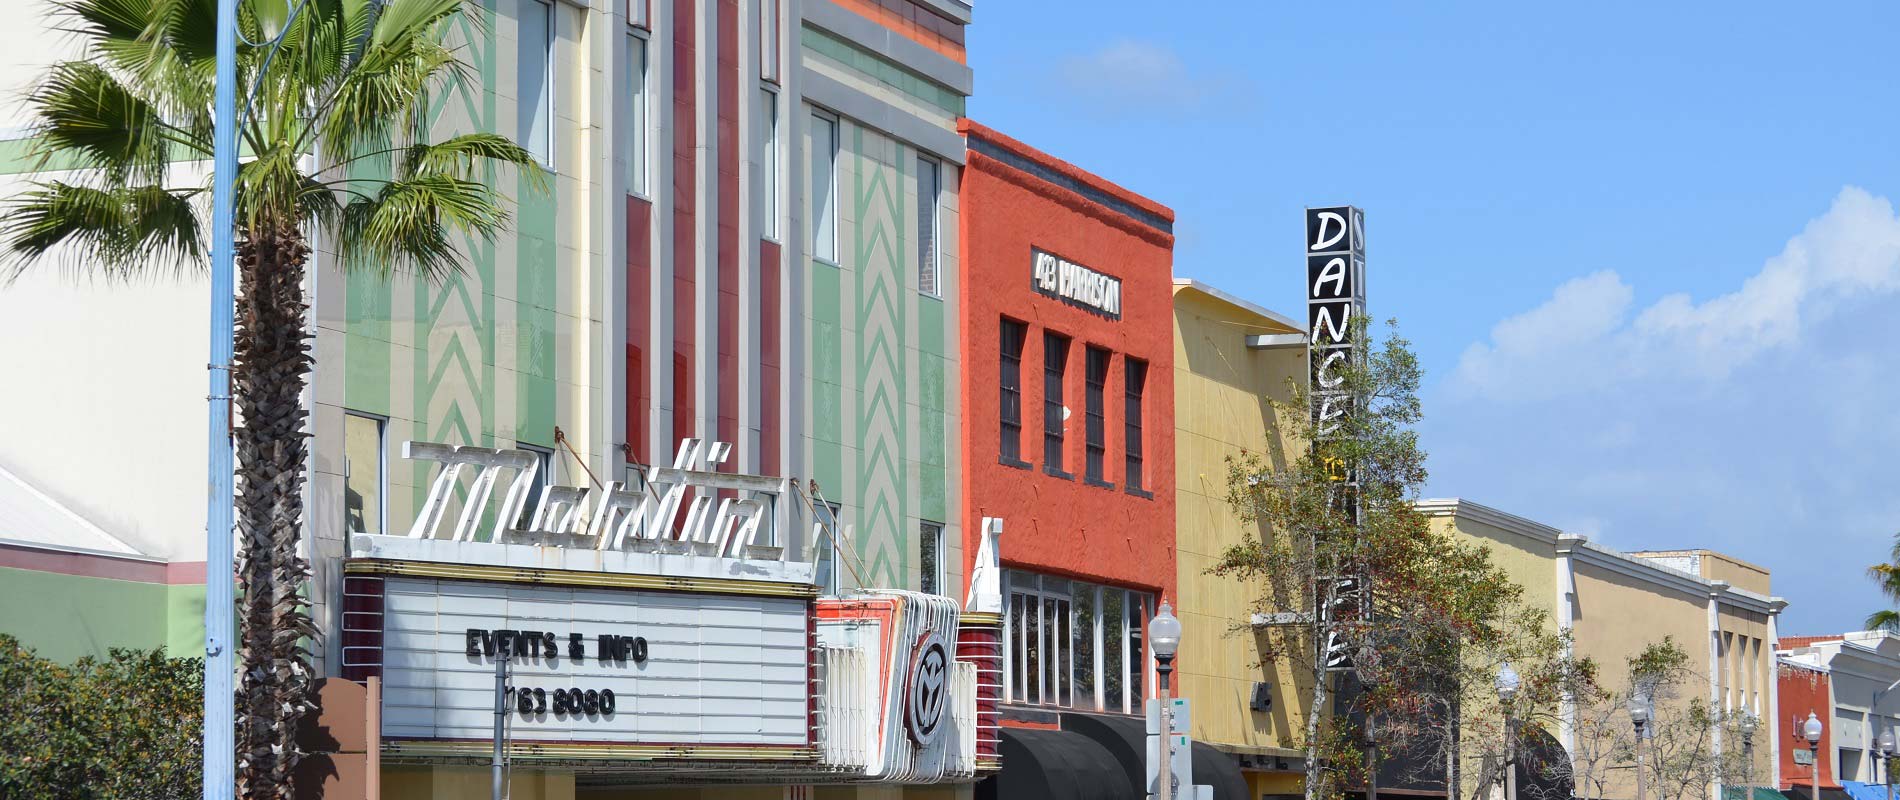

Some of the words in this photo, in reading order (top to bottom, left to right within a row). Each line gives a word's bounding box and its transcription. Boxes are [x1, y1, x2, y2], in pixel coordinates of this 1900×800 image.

[1059, 260, 1119, 315] HARRISON
[1310, 211, 1350, 436] DANCE
[466, 628, 558, 659] EVENTS
[568, 632, 585, 660] &
[598, 634, 648, 662] INFO
[552, 687, 615, 715] 8080
